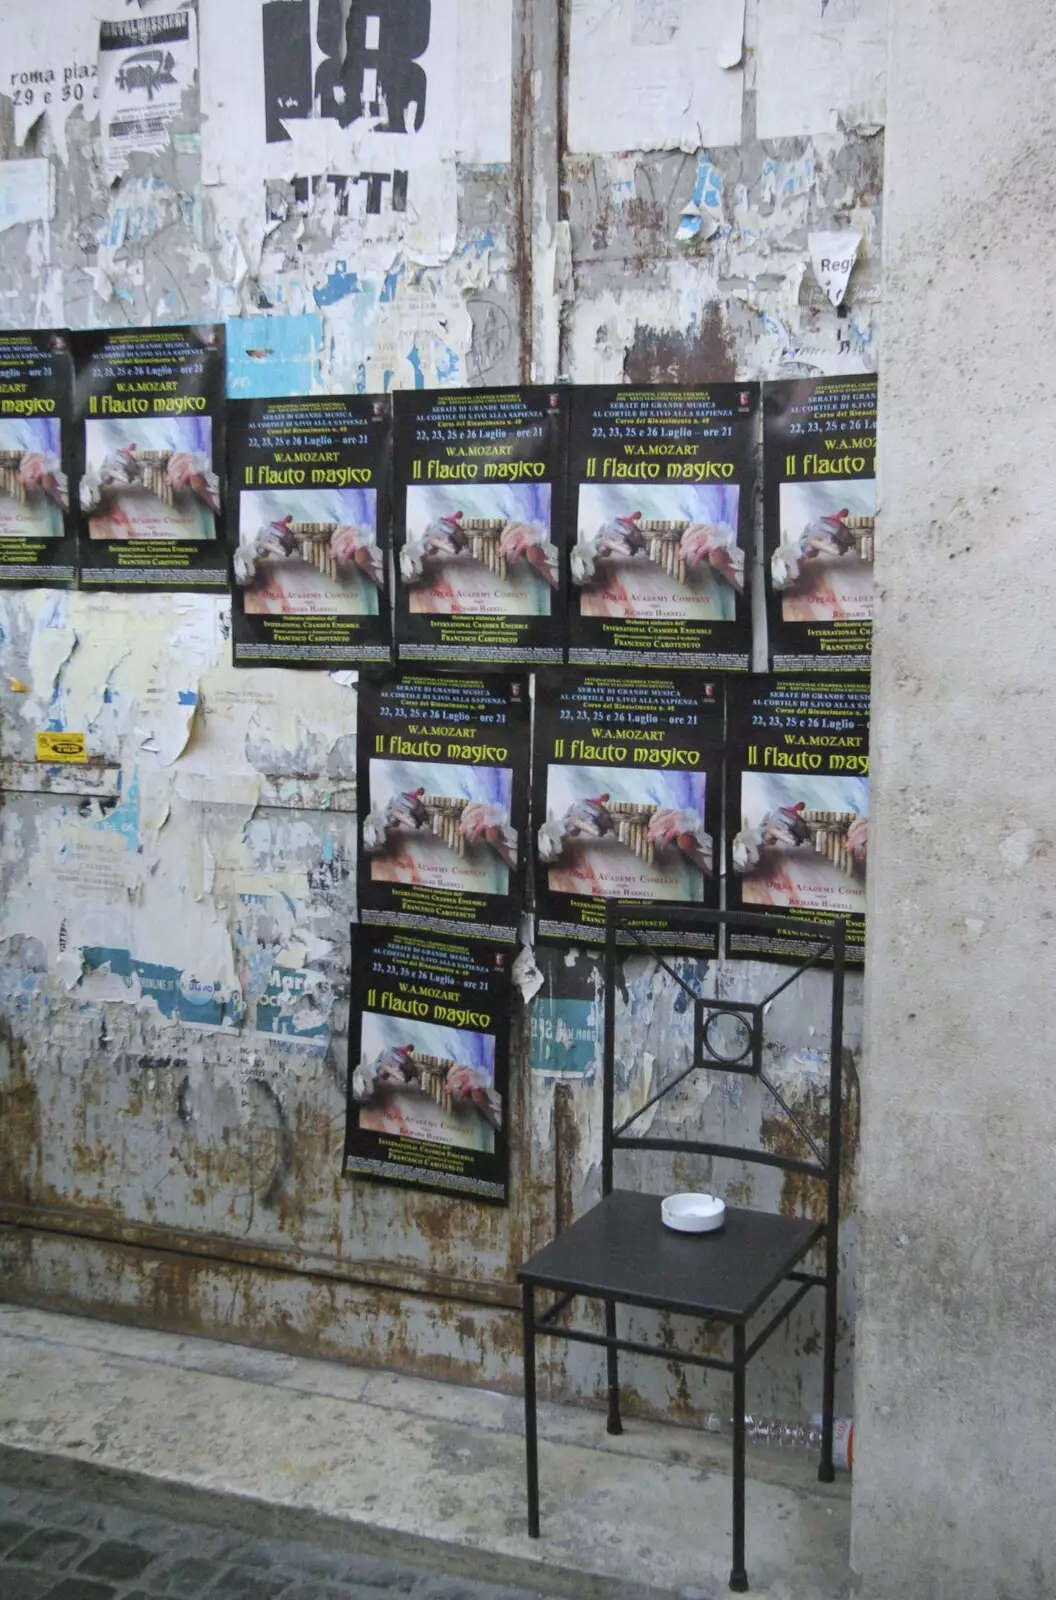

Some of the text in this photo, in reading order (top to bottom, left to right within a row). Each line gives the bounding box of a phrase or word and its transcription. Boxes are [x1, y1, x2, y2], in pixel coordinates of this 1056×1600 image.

[10, 70, 55, 86] roma
[43, 92, 52, 104] e
[61, 83, 84, 101] 30
[116, 382, 176, 392] W.A.MOZART
[2, 399, 55, 414] magico
[90, 396, 207, 414] Il flauto magico
[416, 427, 542, 440] 22, 23, 25 e 26 Luglio ore 21
[592, 426, 732, 440] 22, 23, 25 e 26 Luglio ore 21
[790, 420, 861, 434] 22, 23, 25 e 26
[275, 452, 338, 464] W.A.MOZART
[446, 445, 512, 456] W.A.MOZART
[624, 444, 699, 456] W.A.MOZART
[412, 459, 545, 480] Il flauto magico
[586, 456, 734, 480] Il flauto magico
[786, 454, 865, 476] Il flauto
[245, 463, 372, 485] Il flauto magico
[380, 707, 505, 723] 22, 23, 25 e 26 Luglio ore 21
[560, 710, 696, 724] 22, 23, 25 e 26 Luglio ore 21
[752, 716, 854, 730] 22, 23, 25 e 26 Luglio
[408, 725, 476, 738] W.A.MOZART
[592, 728, 664, 741] W.A.MOZART
[376, 735, 508, 762] Il flauto magico
[784, 735, 860, 747] W.A.MOZART
[554, 738, 700, 766] Il flauto magico
[748, 745, 758, 765] Il
[763, 746, 823, 768] flauto
[373, 962, 488, 990] 22, 23, 25 e 26 Luglio ore 21
[400, 984, 459, 1001] W.A.MOZART
[368, 990, 490, 1026] Il flauto magico
